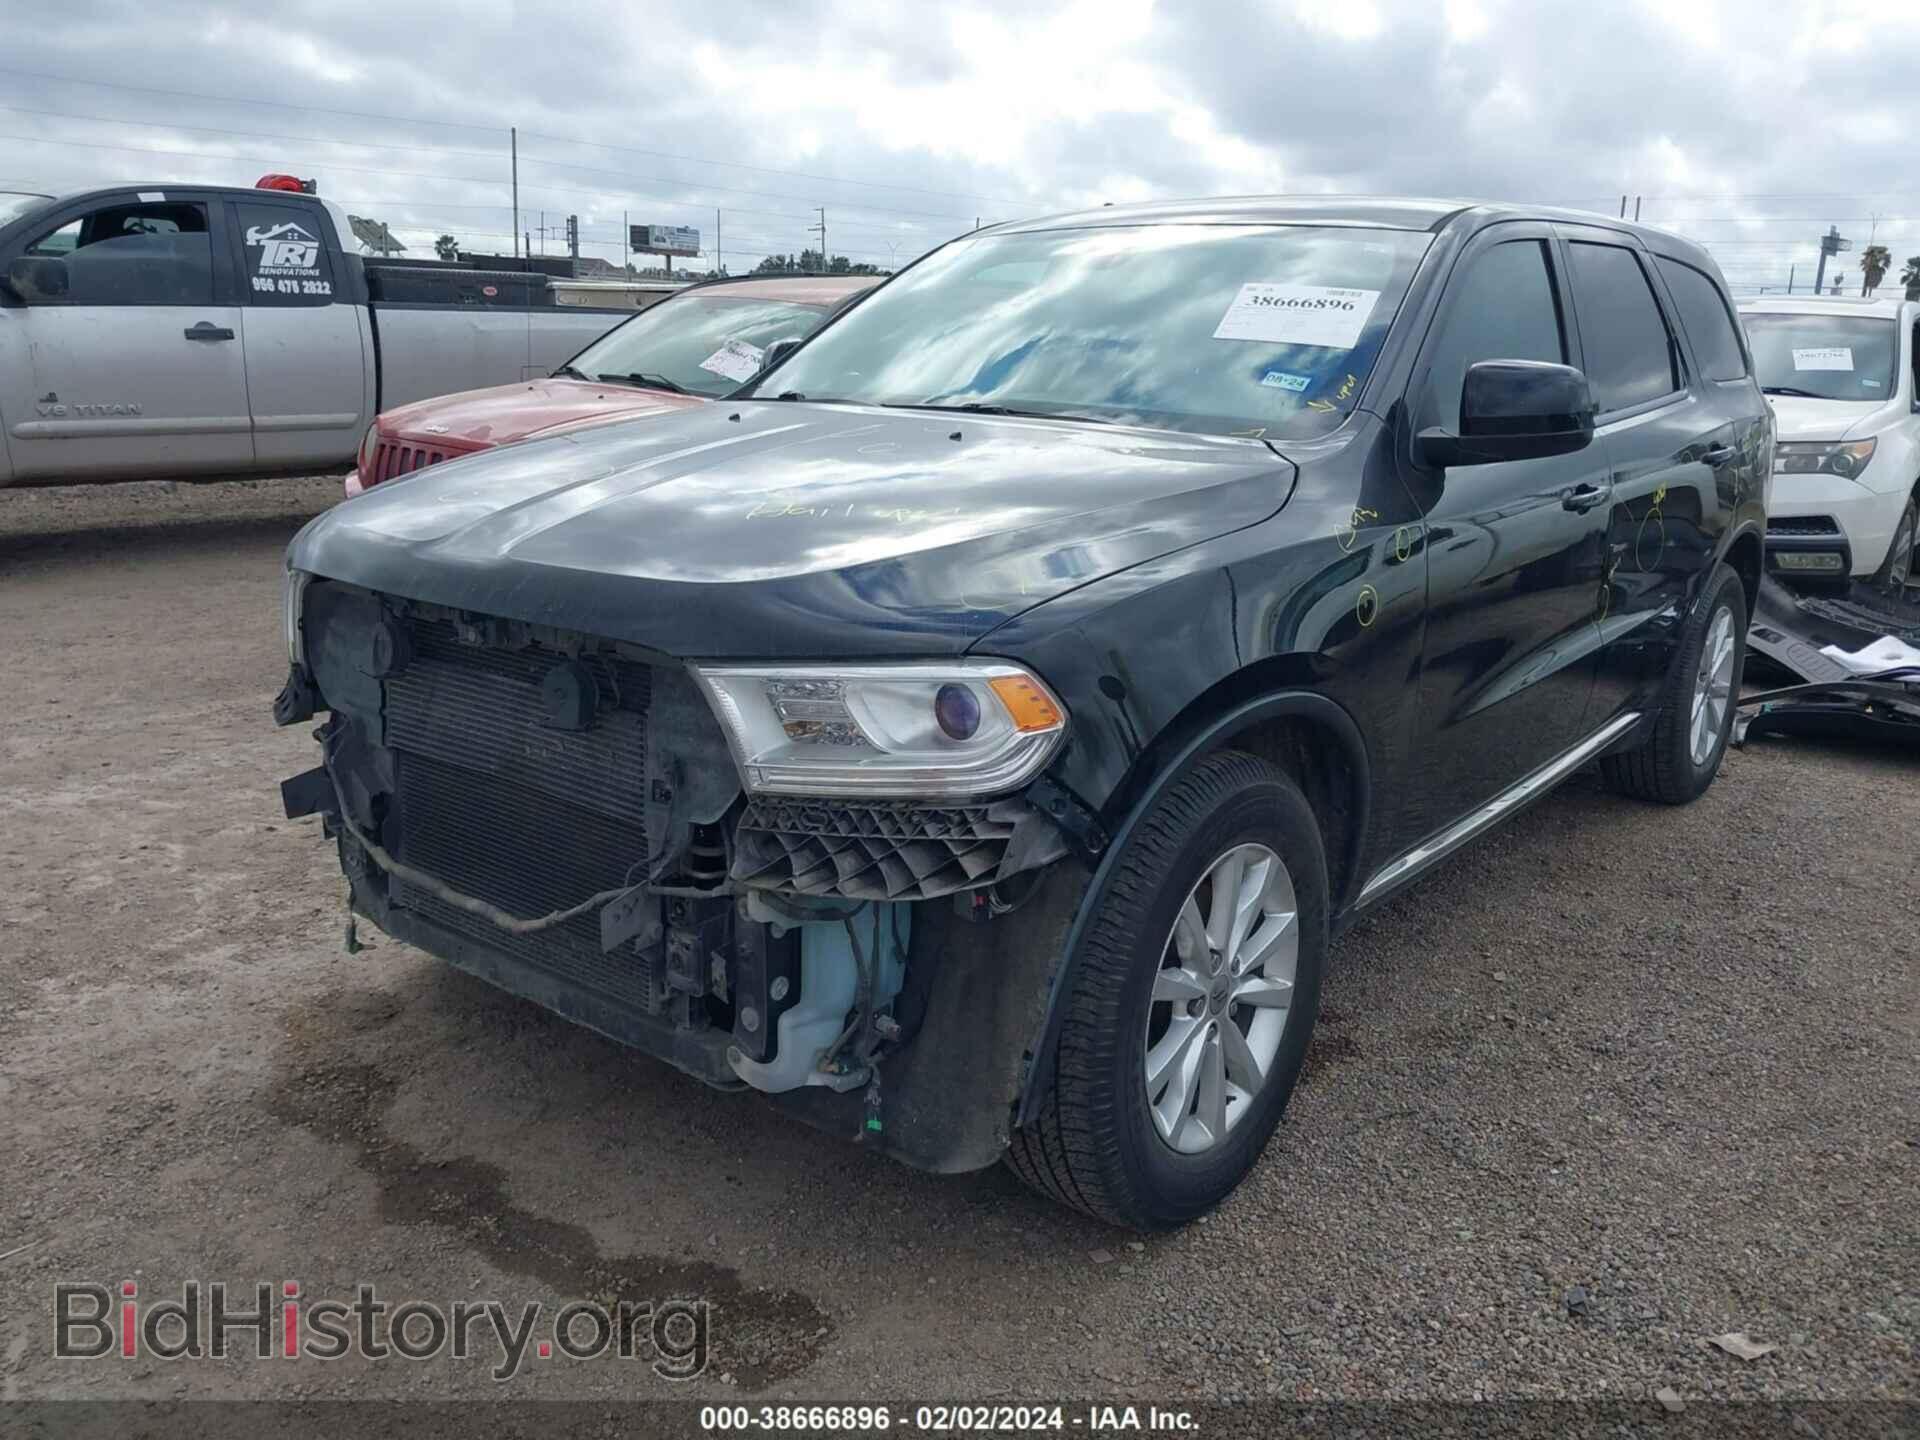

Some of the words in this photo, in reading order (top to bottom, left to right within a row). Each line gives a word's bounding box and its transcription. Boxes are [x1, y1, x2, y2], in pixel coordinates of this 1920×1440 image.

[259, 267, 320, 276] RENOVATIONS
[1245, 295, 1355, 311] 38666896
[72, 402, 144, 417] TITAN
